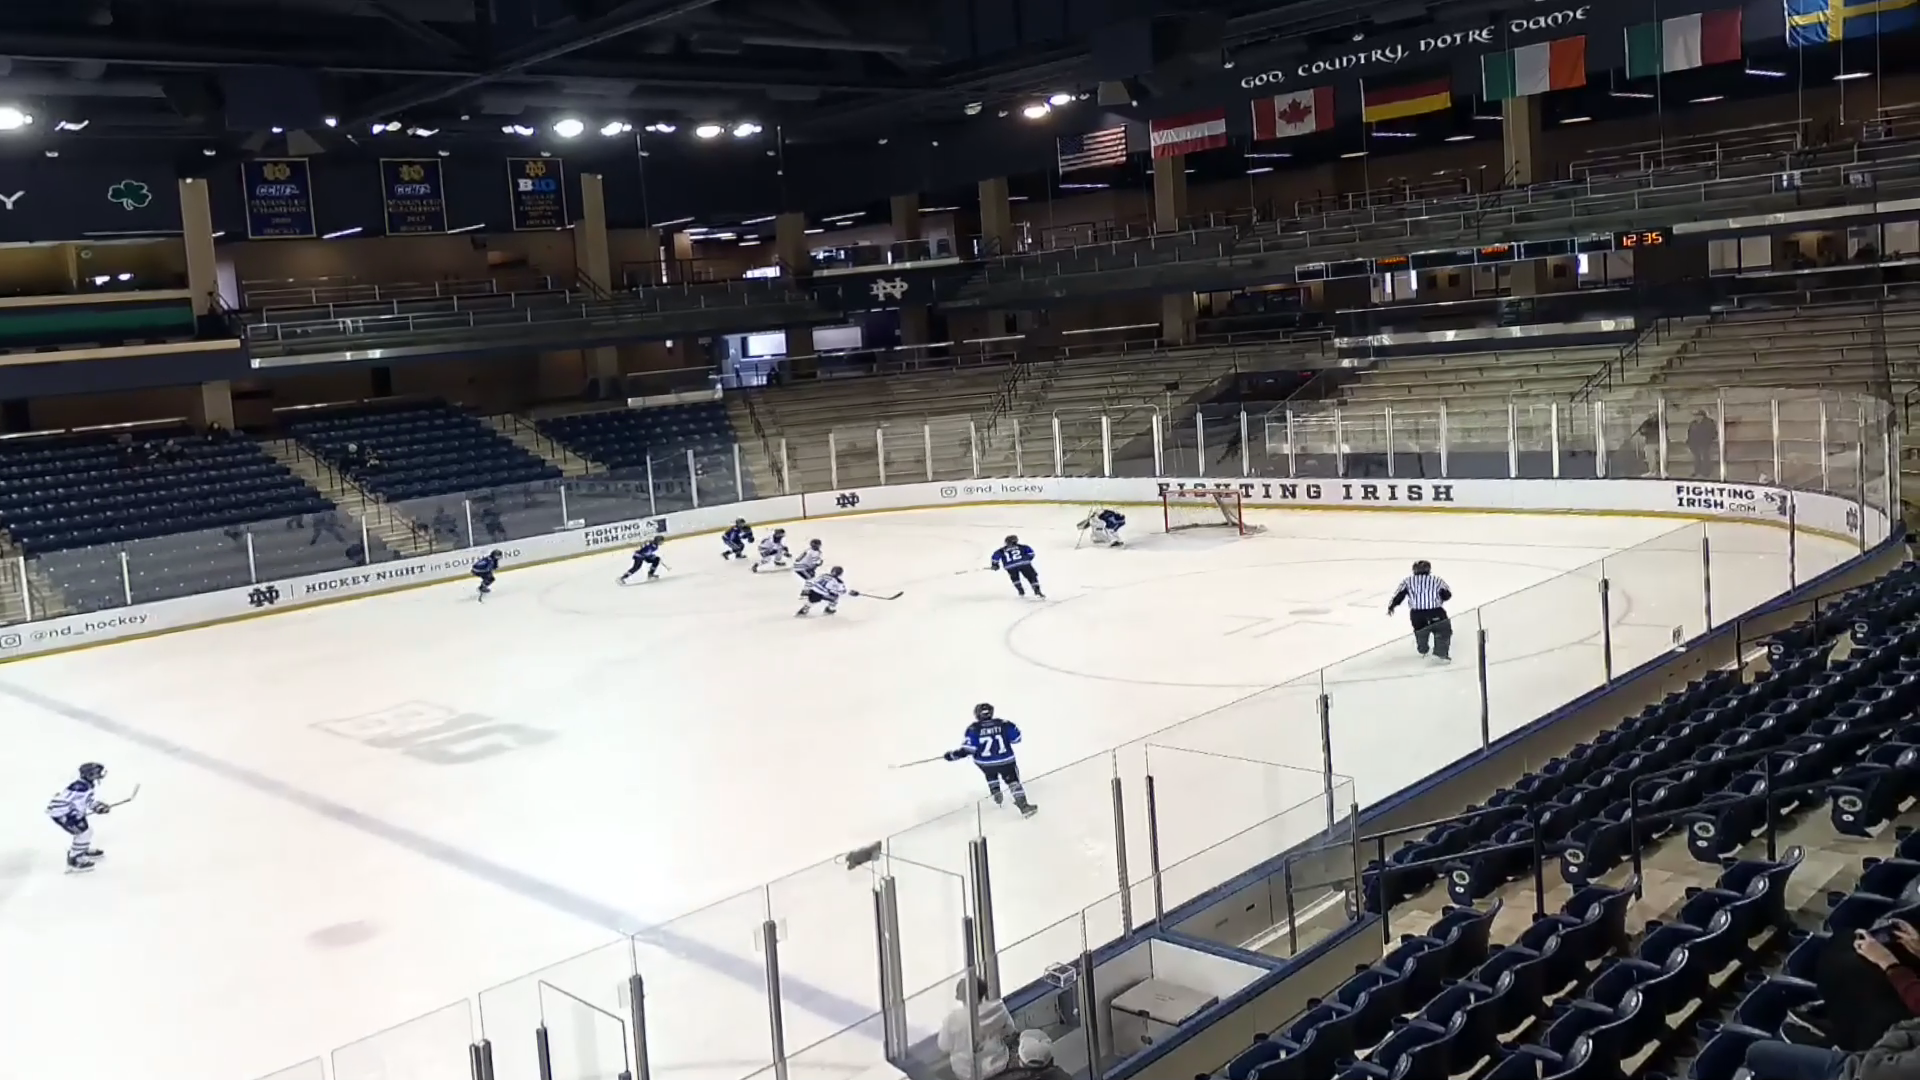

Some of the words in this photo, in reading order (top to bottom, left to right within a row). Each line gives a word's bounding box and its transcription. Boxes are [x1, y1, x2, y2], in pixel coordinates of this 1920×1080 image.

[1241, 70, 1286, 88] GOD,
[1297, 44, 1410, 77] COUNTRY,
[1419, 25, 1496, 52] NOTRE
[1508, 5, 1591, 33] DAME
[1157, 482, 1322, 500] FIGHTING
[1342, 483, 1455, 502] IRISH
[1675, 484, 1756, 500] FIGHTING
[584, 522, 641, 541] FIGHTING
[1004, 549, 1023, 563] 12
[305, 573, 372, 594] HOCKEY
[376, 564, 426, 581] NIGHT
[430, 563, 442, 573] in
[30, 614, 148, 642] @nd_hockey
[978, 734, 1007, 757] 71
